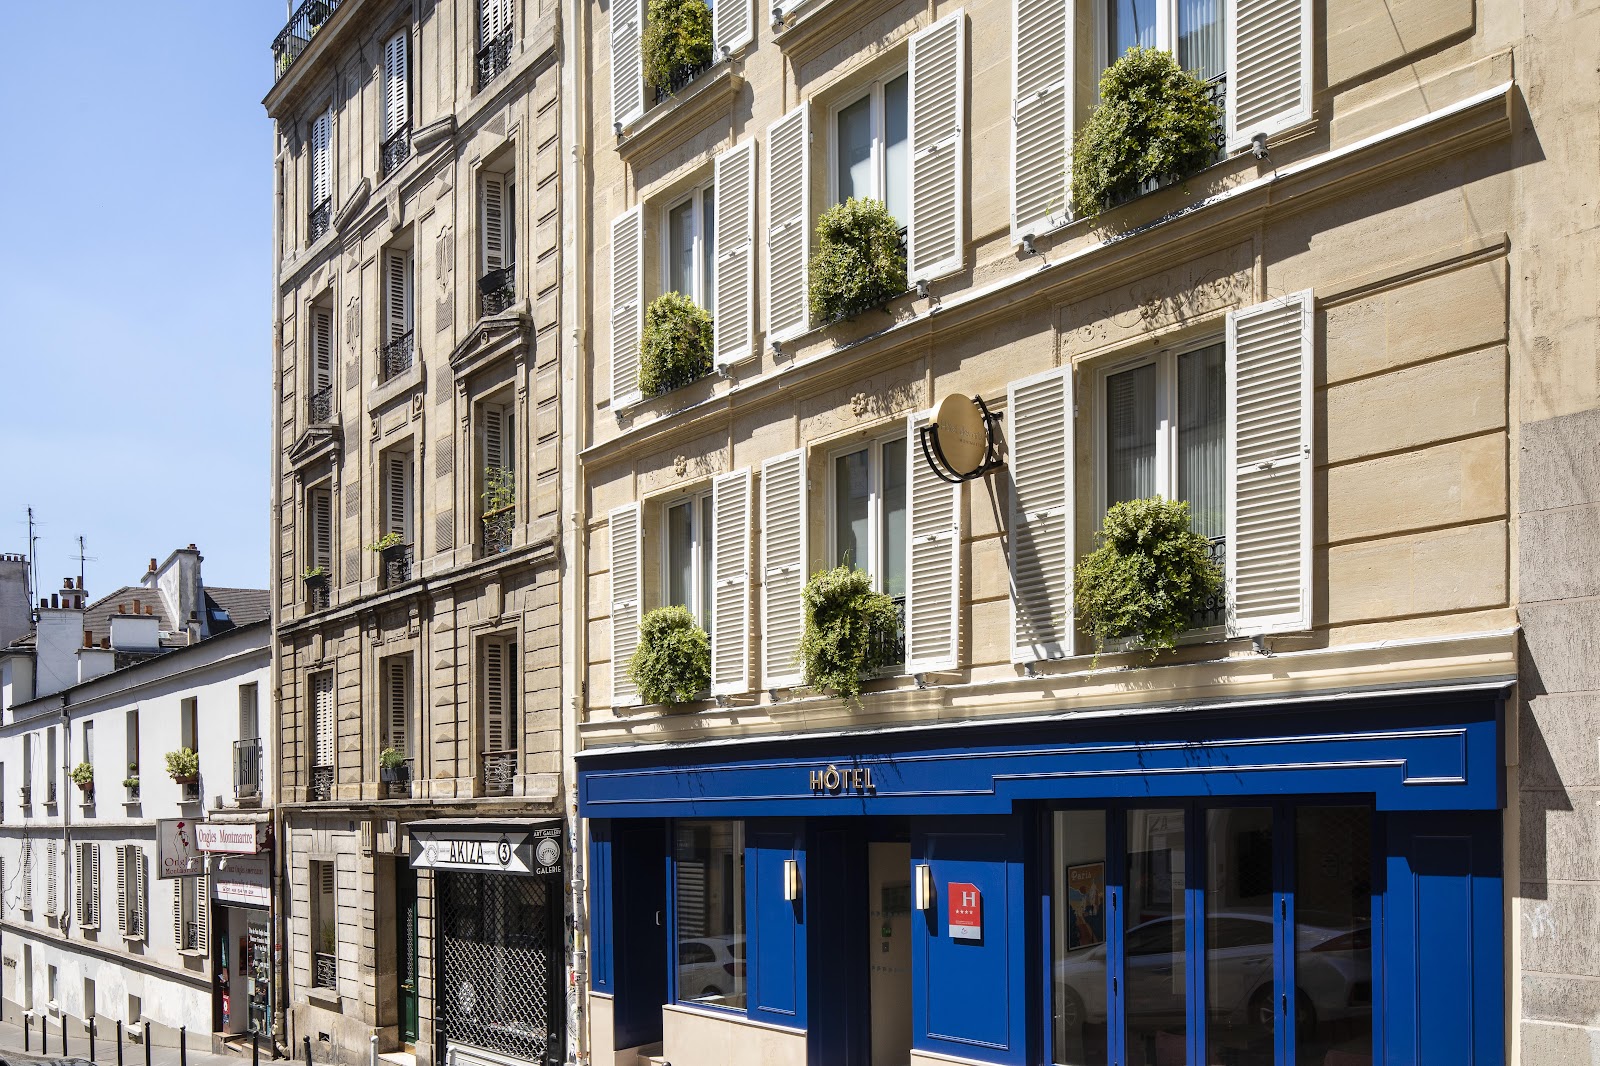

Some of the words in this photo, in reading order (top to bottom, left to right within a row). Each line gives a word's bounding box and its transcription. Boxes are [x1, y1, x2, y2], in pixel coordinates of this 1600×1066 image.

[809, 764, 876, 790] HÔTEL
[198, 829, 216, 848] Ongles
[219, 829, 253, 844] Montmartre
[449, 840, 484, 864] AKIZA
[501, 844, 508, 861] 3
[535, 865, 562, 875] GALERIE
[962, 891, 976, 907] H
